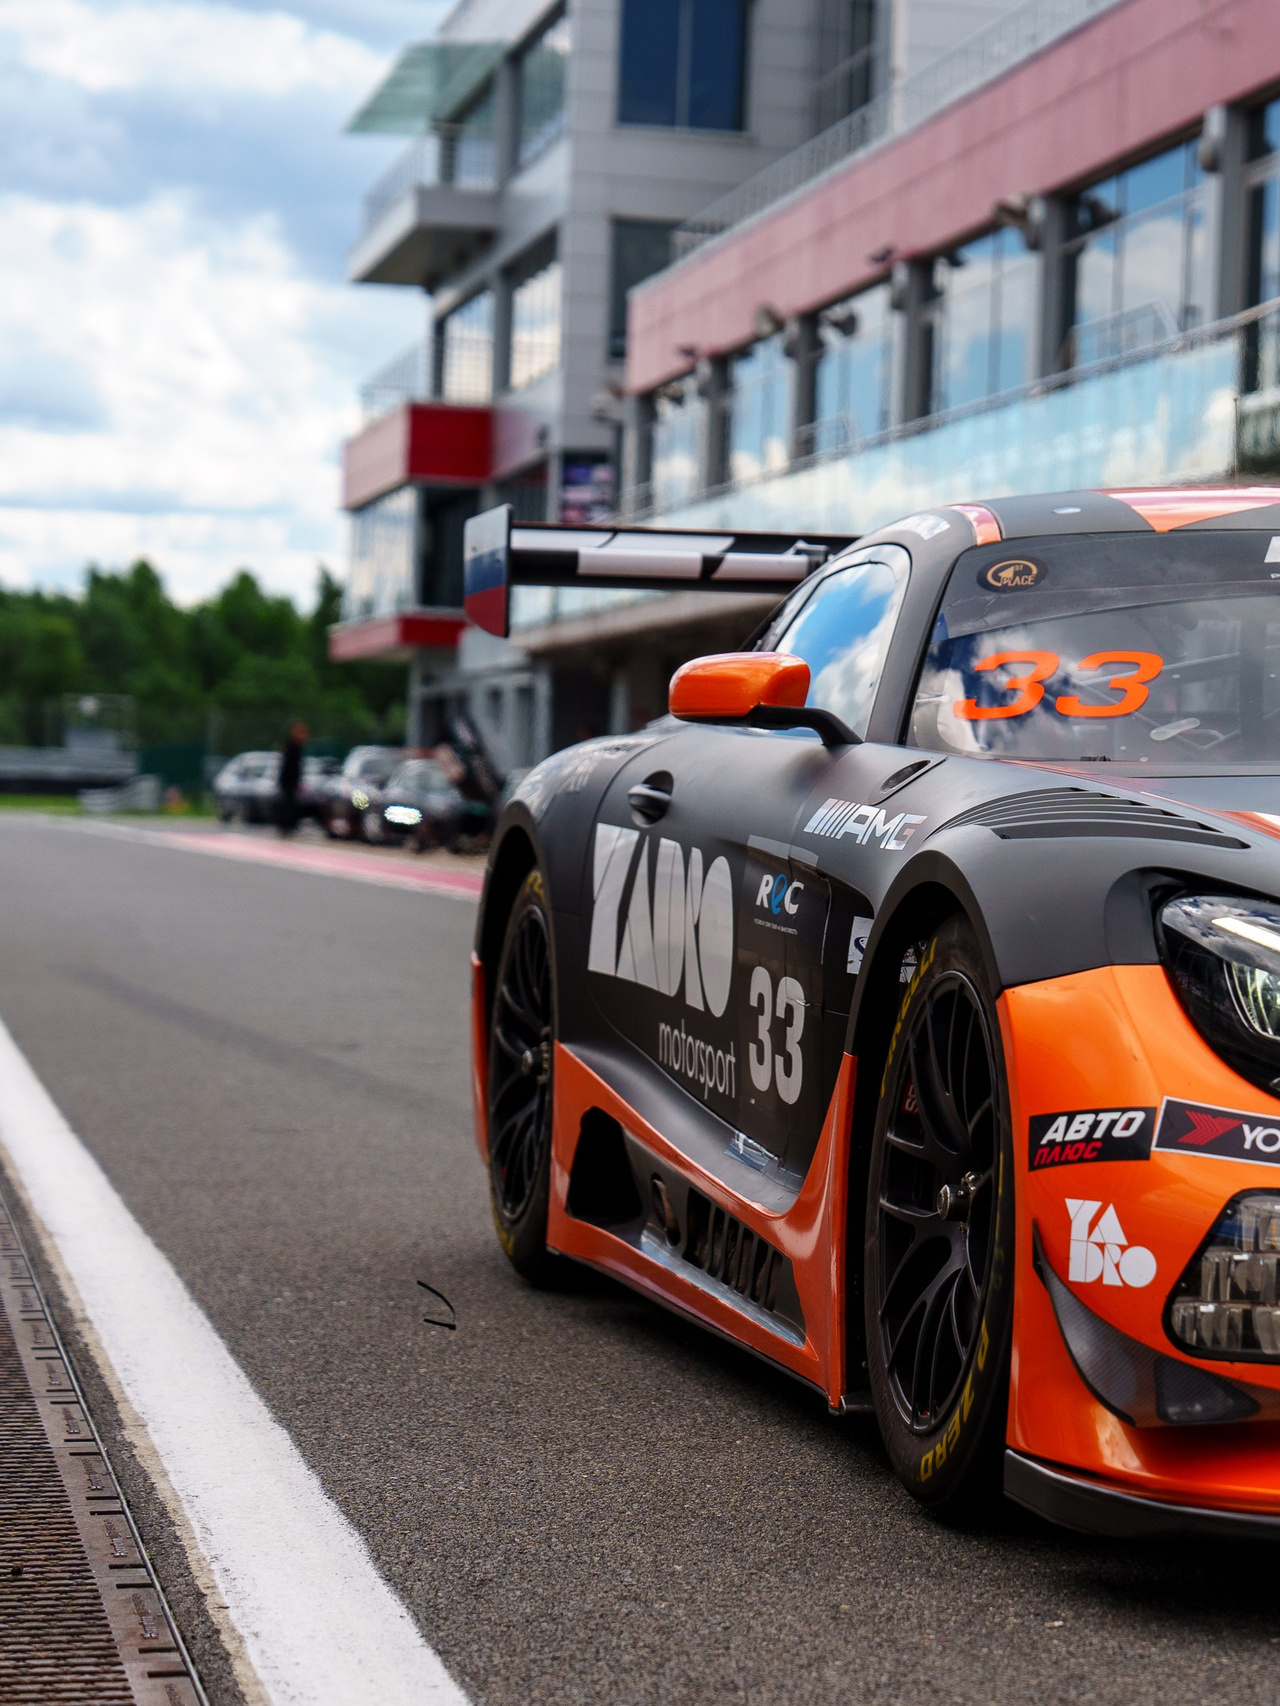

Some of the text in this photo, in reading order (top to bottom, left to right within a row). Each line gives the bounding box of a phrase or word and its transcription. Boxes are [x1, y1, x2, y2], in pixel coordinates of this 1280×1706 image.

[1001, 574, 1036, 586] PLACE
[953, 650, 1164, 721] 33
[837, 803, 928, 851] AMG
[658, 1018, 737, 1099] motorsport
[749, 965, 806, 1105] 33
[1040, 1110, 1146, 1144] АВТО
[1034, 1141, 1102, 1166] ПЛЮС
